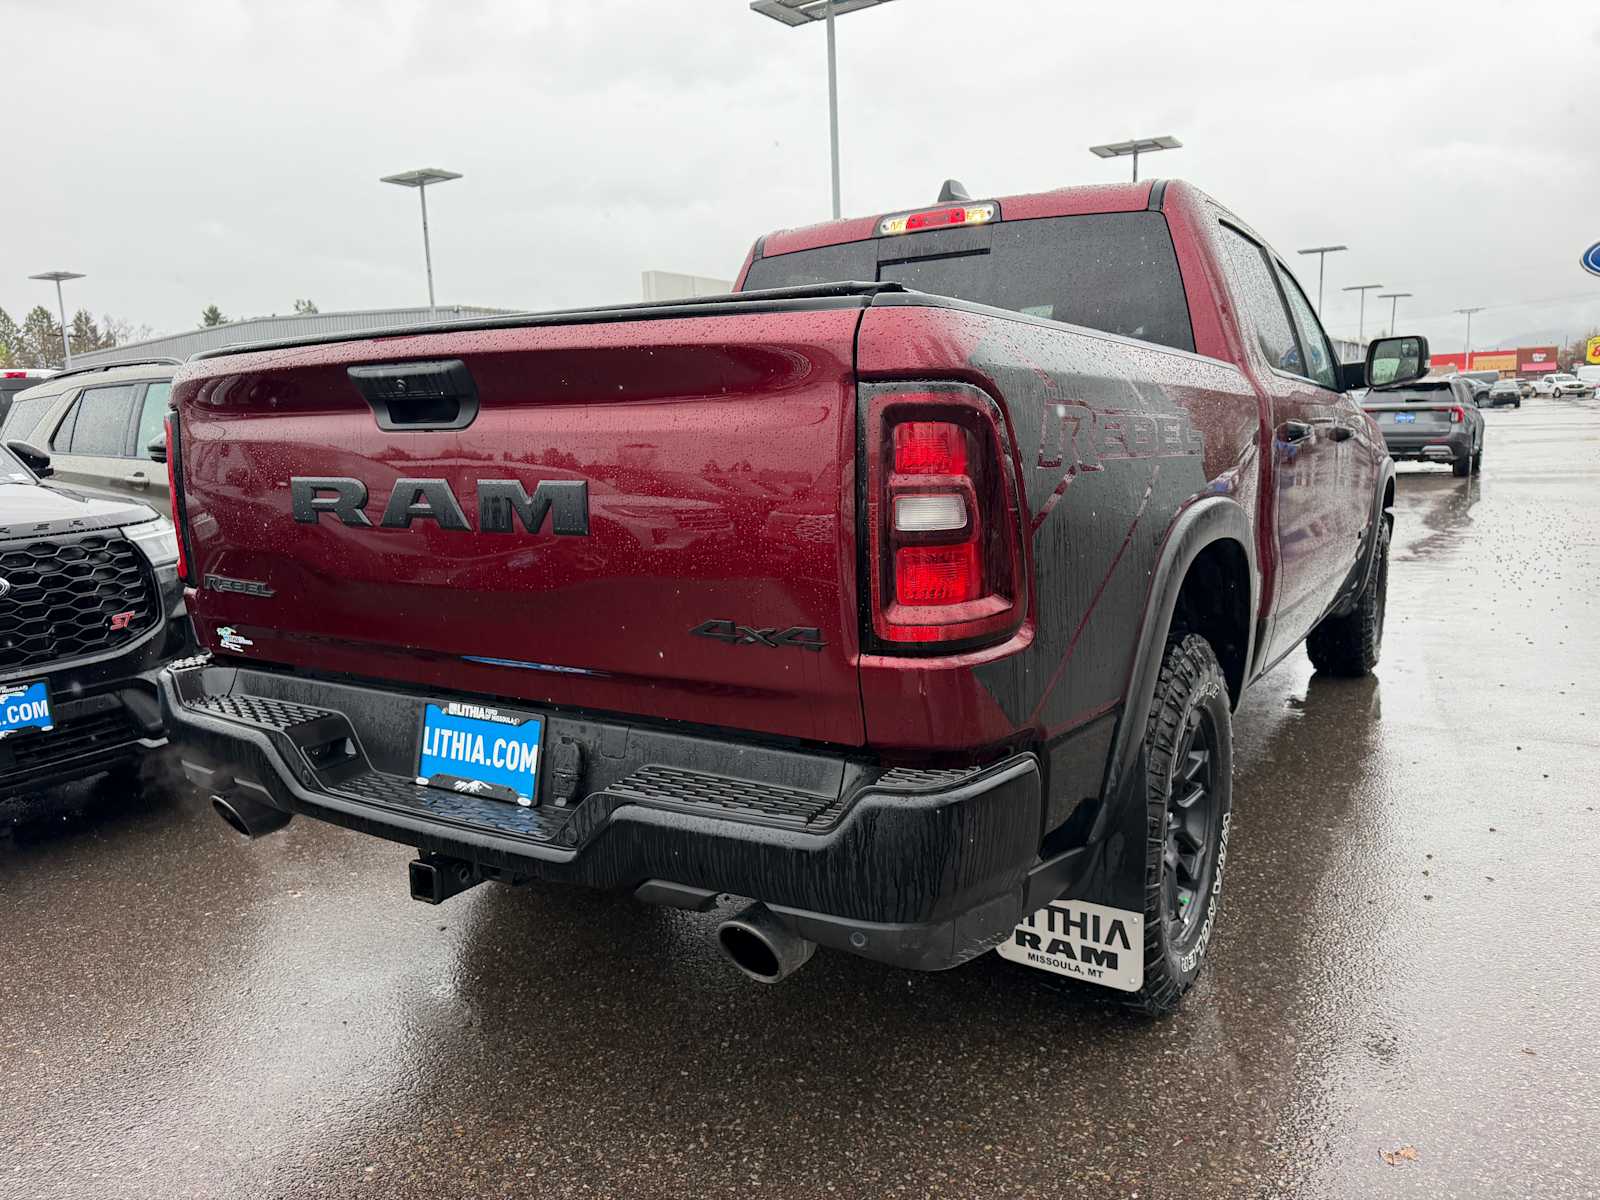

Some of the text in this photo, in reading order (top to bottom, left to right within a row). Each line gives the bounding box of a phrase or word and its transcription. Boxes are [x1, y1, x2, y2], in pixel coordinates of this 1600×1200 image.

[1037, 399, 1204, 472] REBEL
[290, 476, 590, 536] RAM
[203, 573, 277, 598] REBEL
[110, 610, 136, 631] ST
[0, 699, 49, 726] .COM
[456, 703, 486, 720] LITHIA
[422, 726, 539, 775] LITHIA.COM
[1180, 811, 1231, 973] WRANGLER
[1020, 904, 1132, 951] THIA
[1015, 928, 1119, 970] RAM
[1027, 952, 1104, 979] MISSOULA, MT
